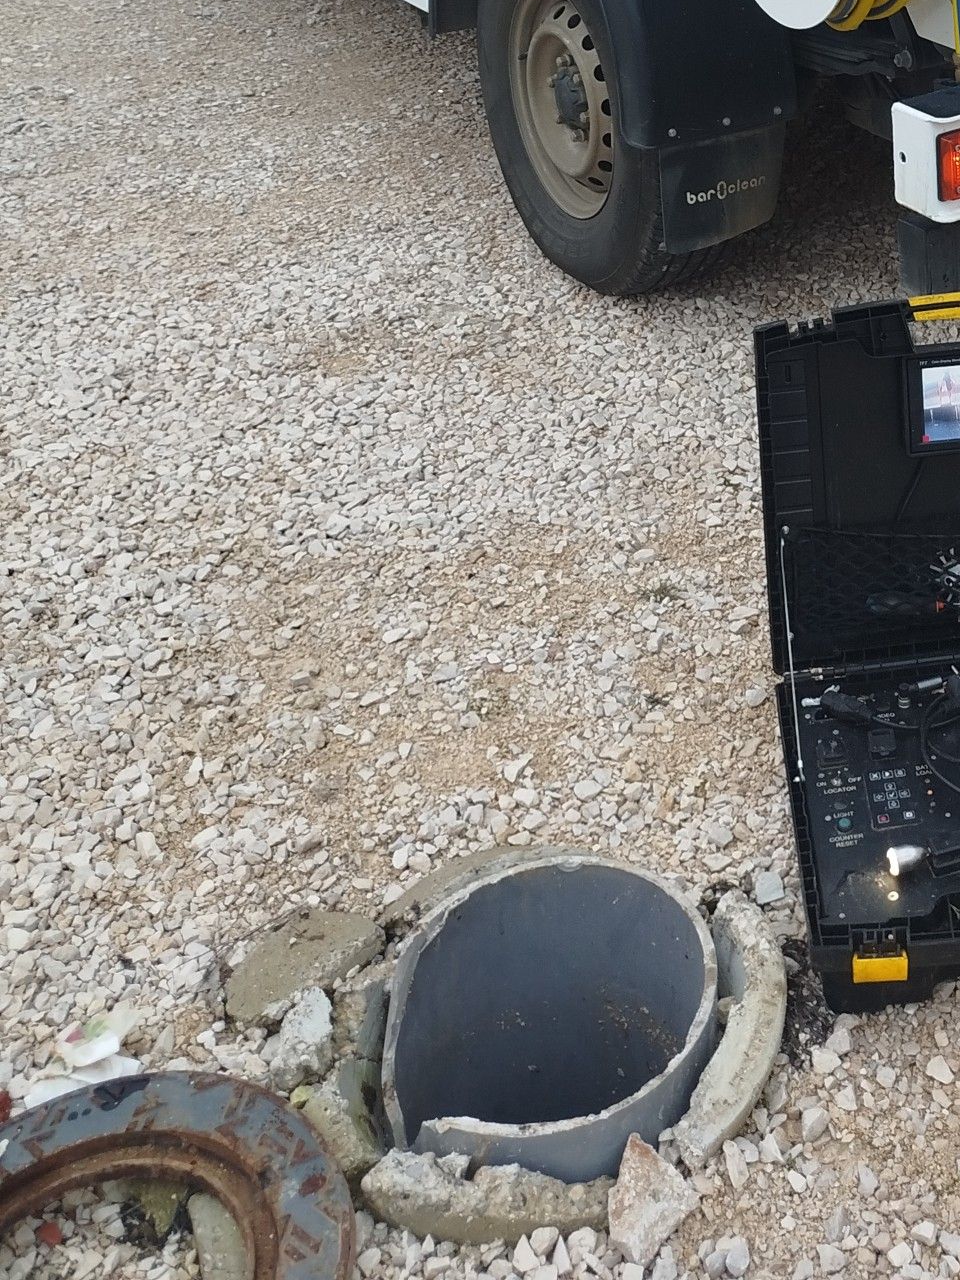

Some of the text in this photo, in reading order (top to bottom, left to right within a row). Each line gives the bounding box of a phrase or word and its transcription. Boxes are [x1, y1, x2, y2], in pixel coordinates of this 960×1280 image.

[847, 776, 862, 784] OFF
[823, 785, 857, 795] LOCATOR
[833, 810, 854, 819] LIGHT
[829, 832, 864, 843] COUNTER
[835, 840, 858, 848] RESET
